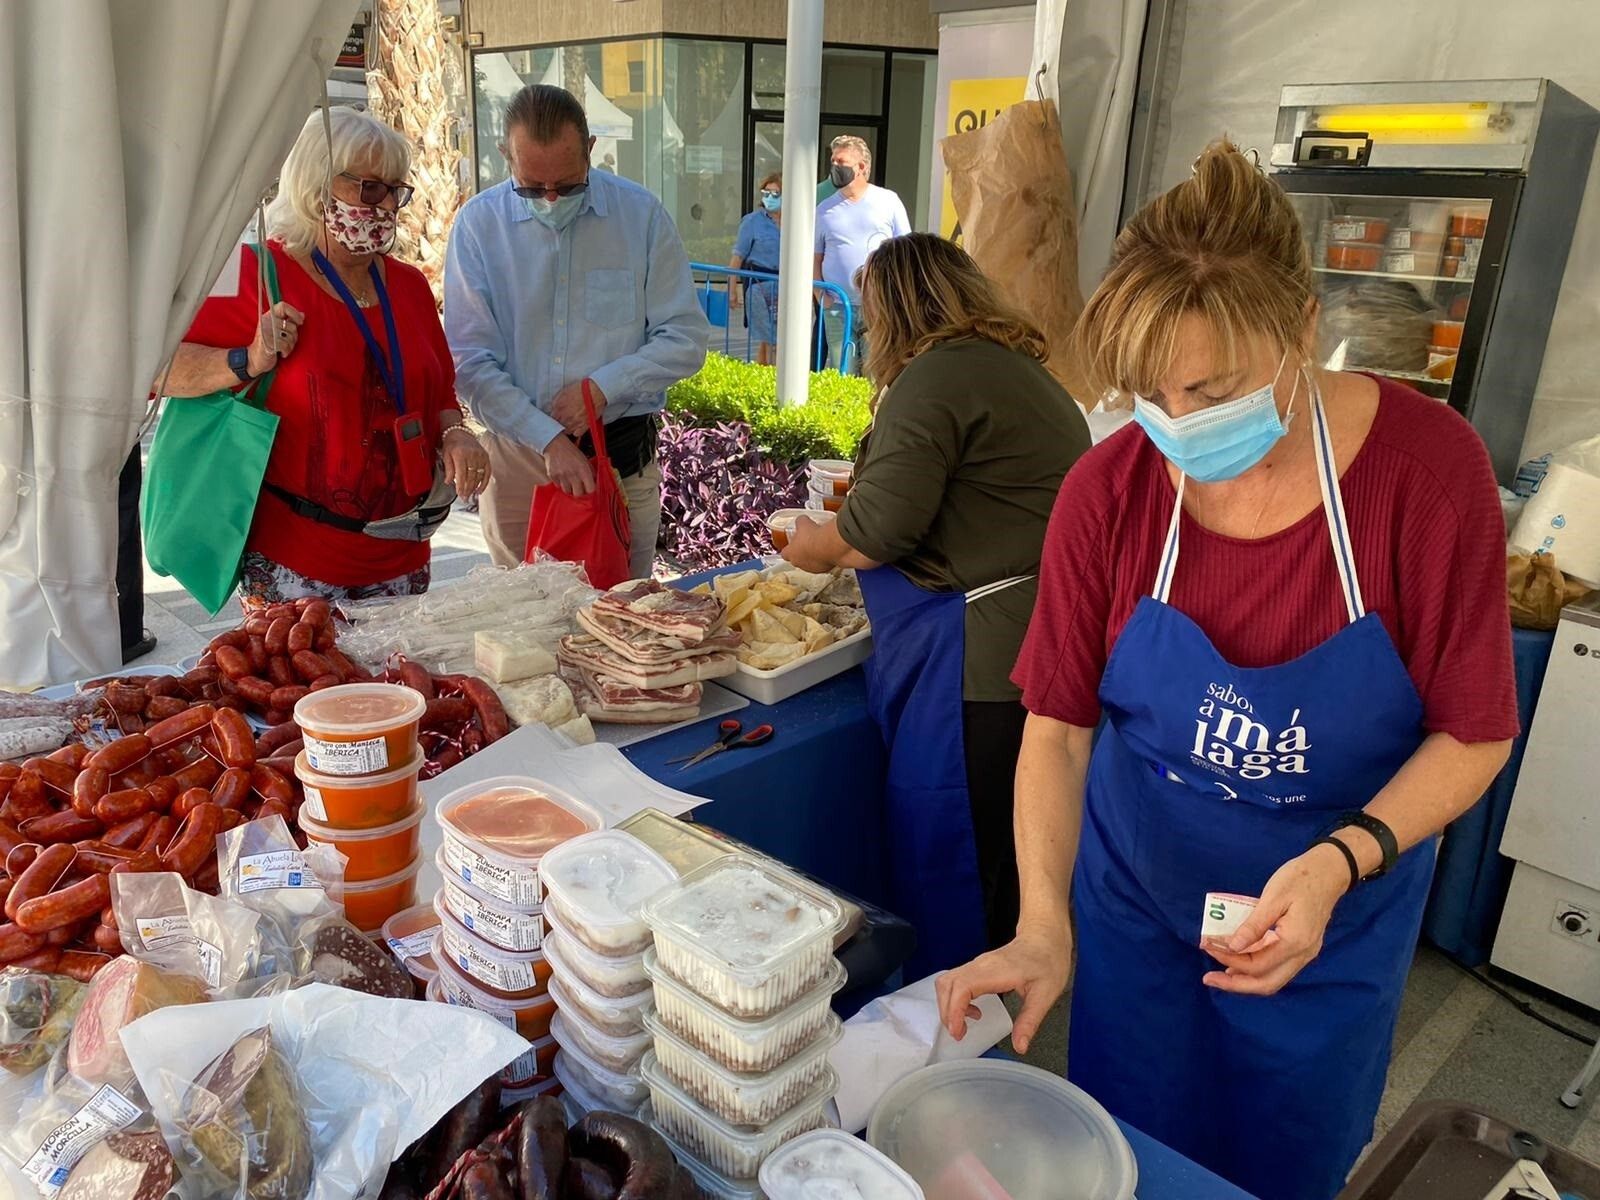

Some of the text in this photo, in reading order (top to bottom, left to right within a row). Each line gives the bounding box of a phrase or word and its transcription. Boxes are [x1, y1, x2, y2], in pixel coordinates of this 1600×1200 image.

[1198, 698, 1215, 719] a
[325, 749, 360, 757] IBERICA
[1189, 718, 1311, 780] laga
[1284, 794, 1307, 804] une
[474, 862, 507, 883] IBERICA
[476, 910, 508, 931] IBERICA
[1208, 902, 1227, 921] 10
[50, 1122, 92, 1161] MORCILLA
